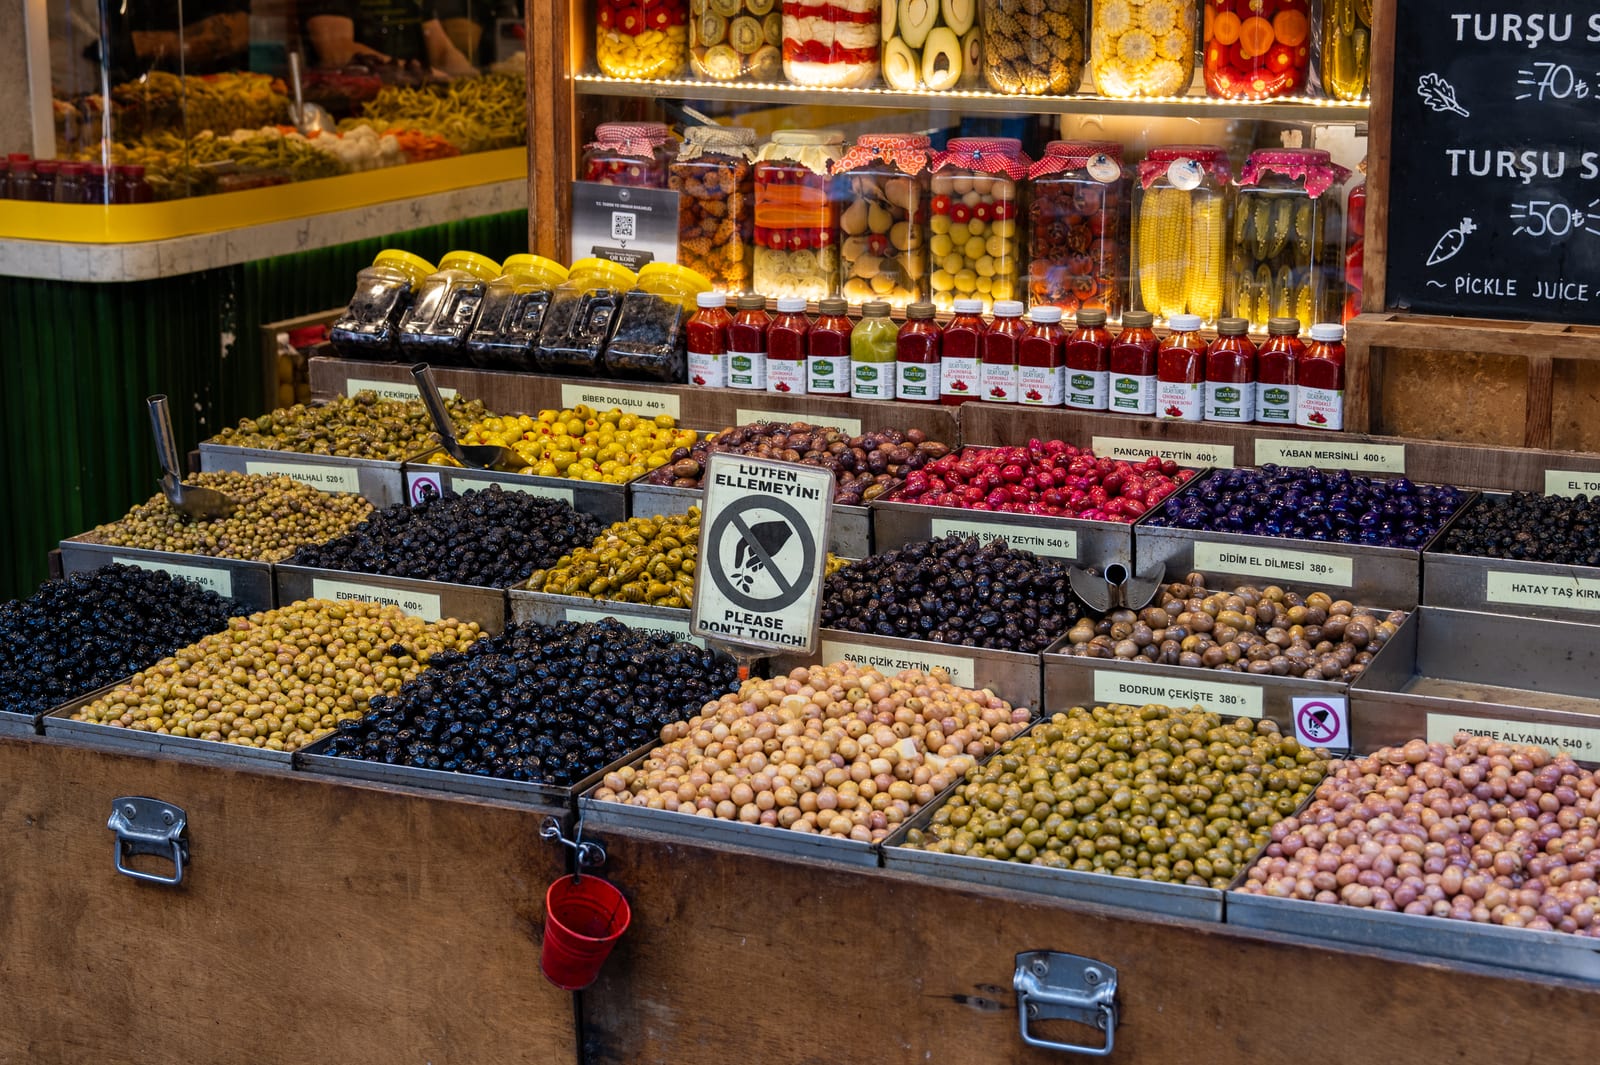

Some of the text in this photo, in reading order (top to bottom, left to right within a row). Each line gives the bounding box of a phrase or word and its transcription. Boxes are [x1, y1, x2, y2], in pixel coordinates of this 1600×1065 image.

[1451, 14, 1572, 48] TURŞU
[1446, 149, 1565, 184] TURŞU
[582, 394, 605, 404] BİBER
[606, 396, 643, 407] DOLGULU
[646, 401, 660, 409] 440
[1160, 450, 1192, 460] ZEYTİN
[1280, 449, 1312, 458] YABAN
[1314, 450, 1359, 461] MERSİNLİ
[1363, 454, 1379, 462] 400
[291, 472, 323, 482] HALHALİ
[1568, 481, 1581, 490] EL
[715, 474, 820, 500] ELLEMEYİN!
[982, 532, 1010, 542] SİYAH
[1012, 535, 1044, 546] ZEYTİN
[1047, 540, 1062, 548] 540
[1219, 552, 1247, 565] DİDİM
[1249, 557, 1262, 566] EL
[1264, 557, 1305, 571] DİLMESİ
[1310, 564, 1326, 573] 380
[336, 591, 372, 603] EDREMİT
[373, 596, 400, 607] KIRMA
[1512, 583, 1549, 595] HATAY
[1552, 586, 1573, 598] TAŞ
[724, 610, 784, 630] PLEASE
[699, 620, 807, 647] DON'T TOUCH!
[844, 653, 867, 664] SARI
[869, 656, 894, 668] ÇİZİK
[896, 660, 930, 672] ZEYTİN
[1119, 684, 1165, 697] BODRUM
[1168, 688, 1214, 703] ÇEKİŞTE
[1219, 694, 1237, 705] 380
[1502, 732, 1560, 746] ALYANAK
[1562, 738, 1582, 749] 540
